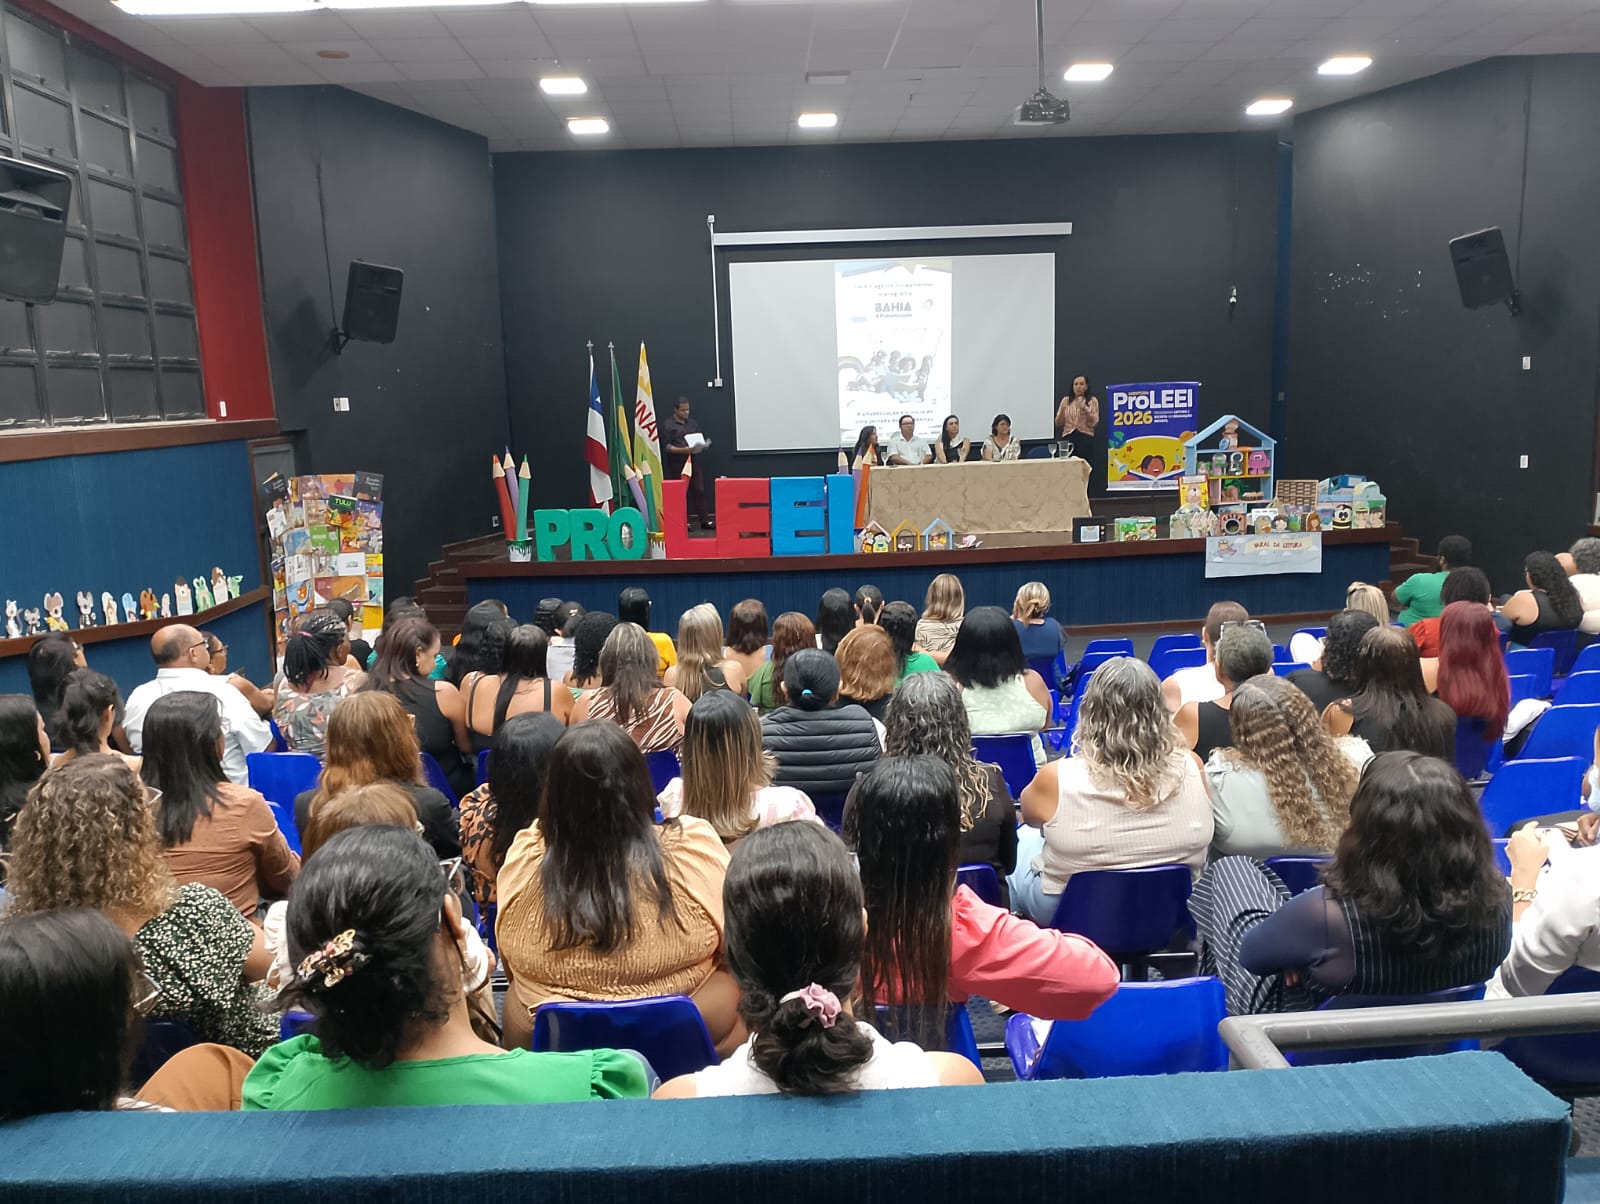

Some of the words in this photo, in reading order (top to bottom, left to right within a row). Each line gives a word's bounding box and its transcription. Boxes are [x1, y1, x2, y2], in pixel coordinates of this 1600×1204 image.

[875, 302, 912, 312] BAHIA
[1113, 388, 1193, 411] ProLEEI
[1113, 410, 1153, 426] 2026
[534, 506, 649, 562] PRO
[662, 474, 854, 560] LEEI
